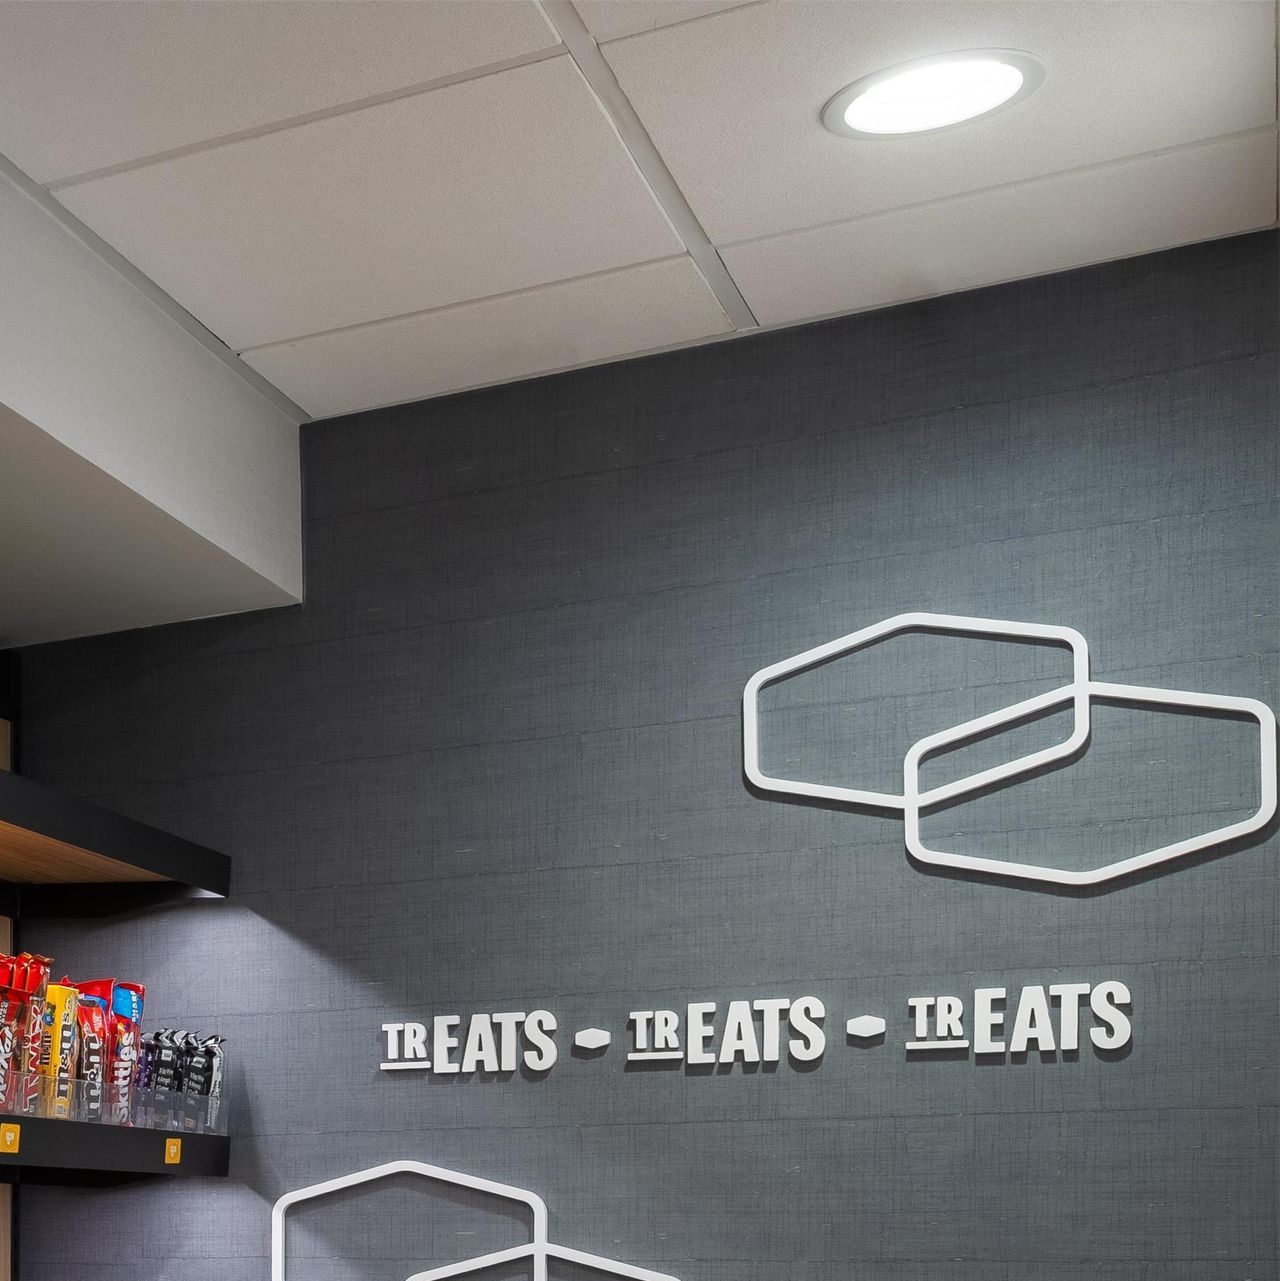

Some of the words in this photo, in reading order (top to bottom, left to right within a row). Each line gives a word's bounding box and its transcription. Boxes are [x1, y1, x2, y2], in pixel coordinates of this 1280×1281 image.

[24, 1002, 45, 1111] TWIX
[381, 1009, 558, 1074] TREATS
[627, 996, 827, 1064] TREATS
[906, 980, 1132, 1053] TREATS
